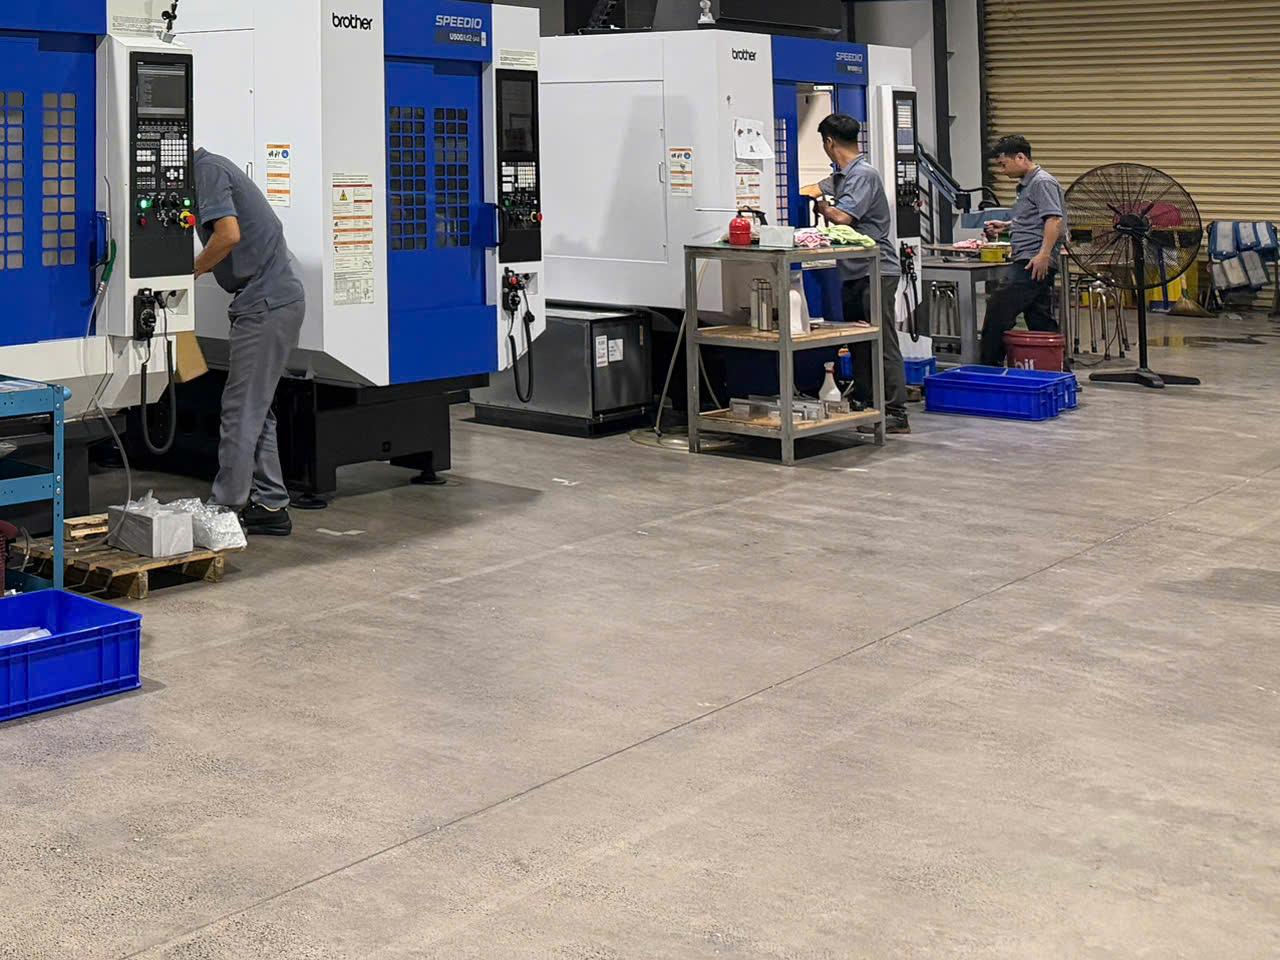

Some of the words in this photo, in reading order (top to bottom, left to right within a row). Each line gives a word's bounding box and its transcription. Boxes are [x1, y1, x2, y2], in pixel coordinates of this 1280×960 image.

[332, 12, 373, 30] brother
[435, 14, 483, 29] SPEEDIO
[731, 48, 757, 61] brother
